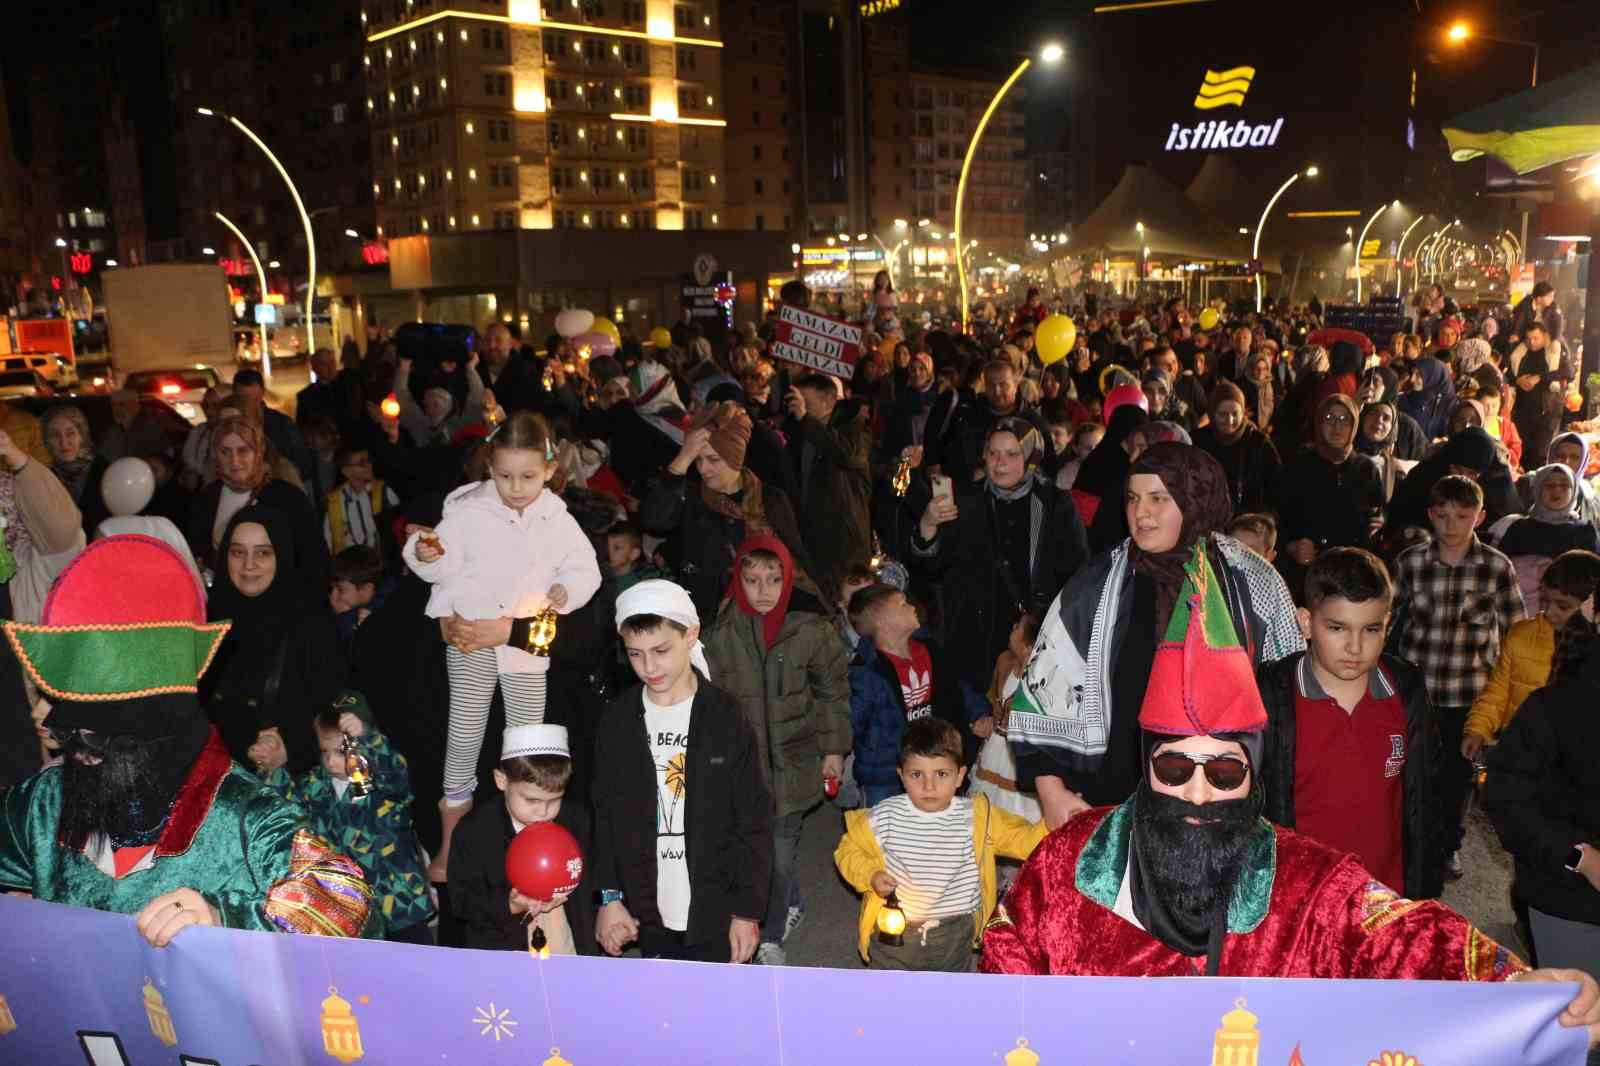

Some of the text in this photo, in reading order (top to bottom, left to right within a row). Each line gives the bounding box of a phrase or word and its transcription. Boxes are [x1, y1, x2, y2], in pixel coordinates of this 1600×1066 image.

[1165, 117, 1285, 151] istikbal
[782, 307, 860, 342] RAMAZAN
[775, 343, 852, 376] RAMAZAN
